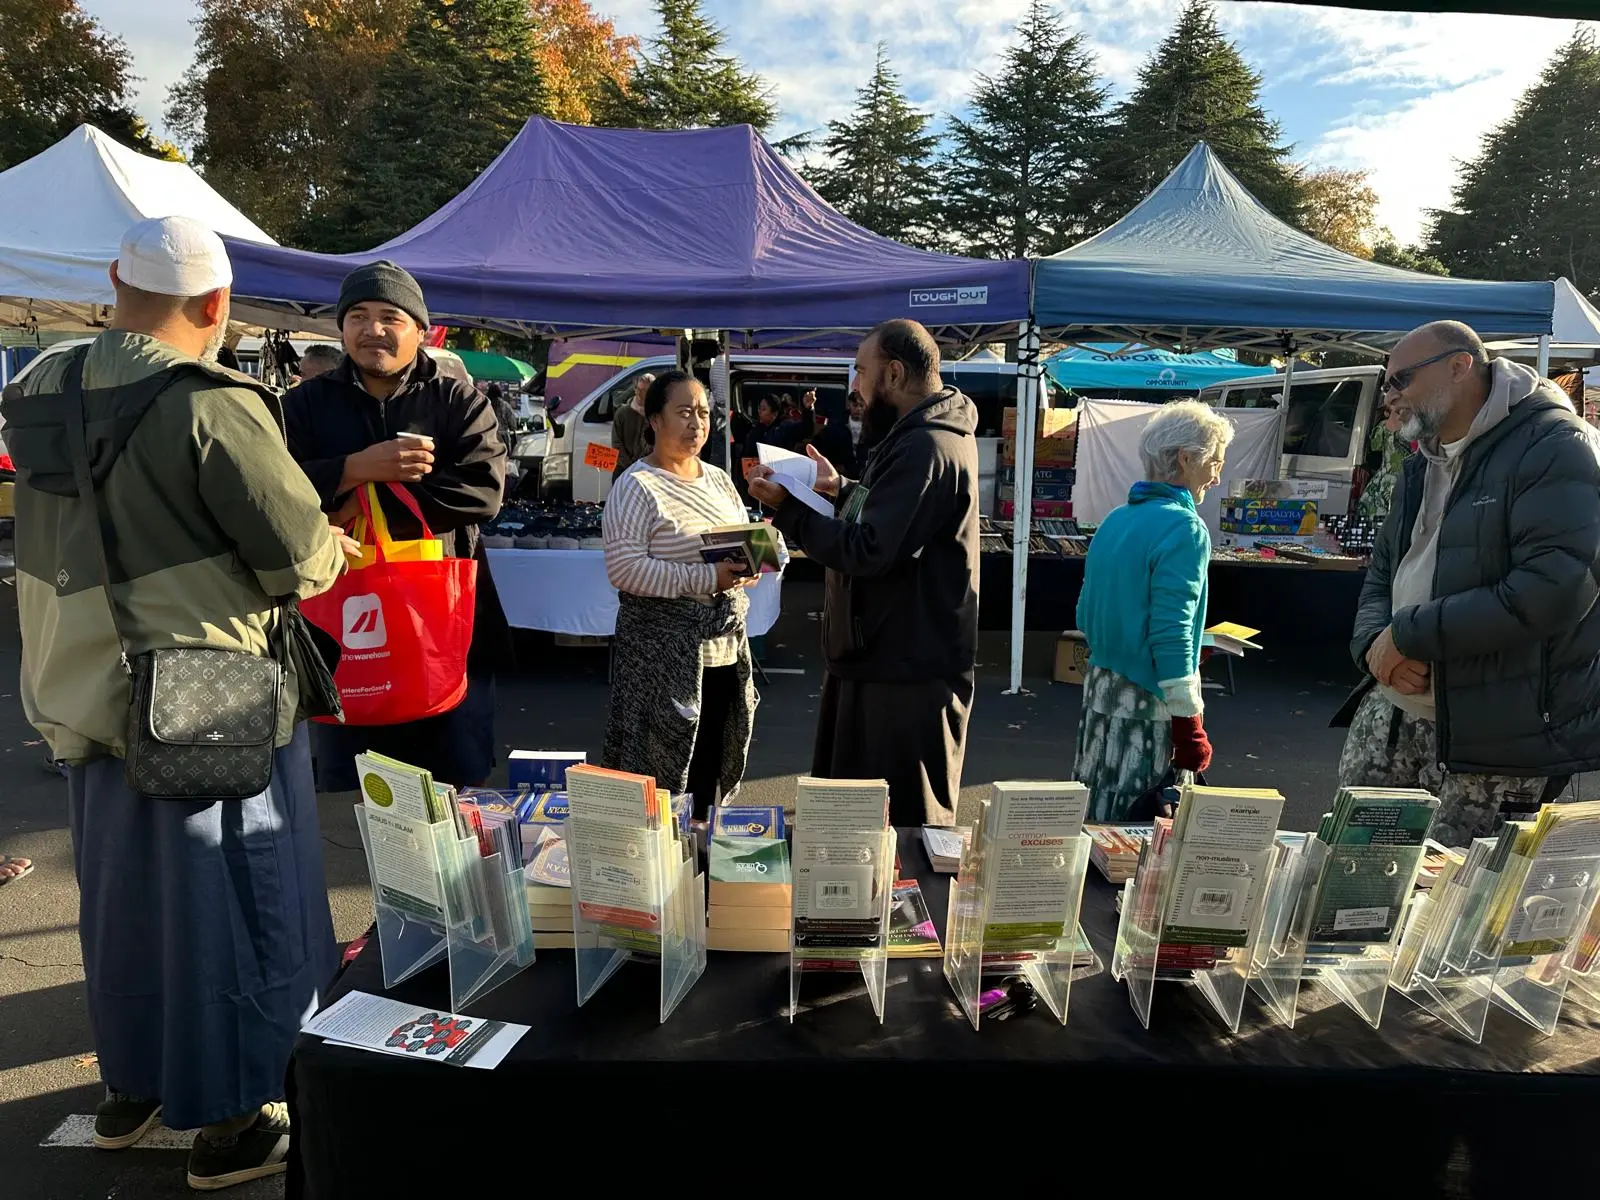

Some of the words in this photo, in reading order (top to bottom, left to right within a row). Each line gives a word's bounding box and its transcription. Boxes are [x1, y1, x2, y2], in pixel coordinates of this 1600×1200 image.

[913, 292, 957, 302] TOUGH
[959, 291, 986, 299] OUT
[1008, 832, 1047, 840] common
[1021, 838, 1065, 847] excuses
